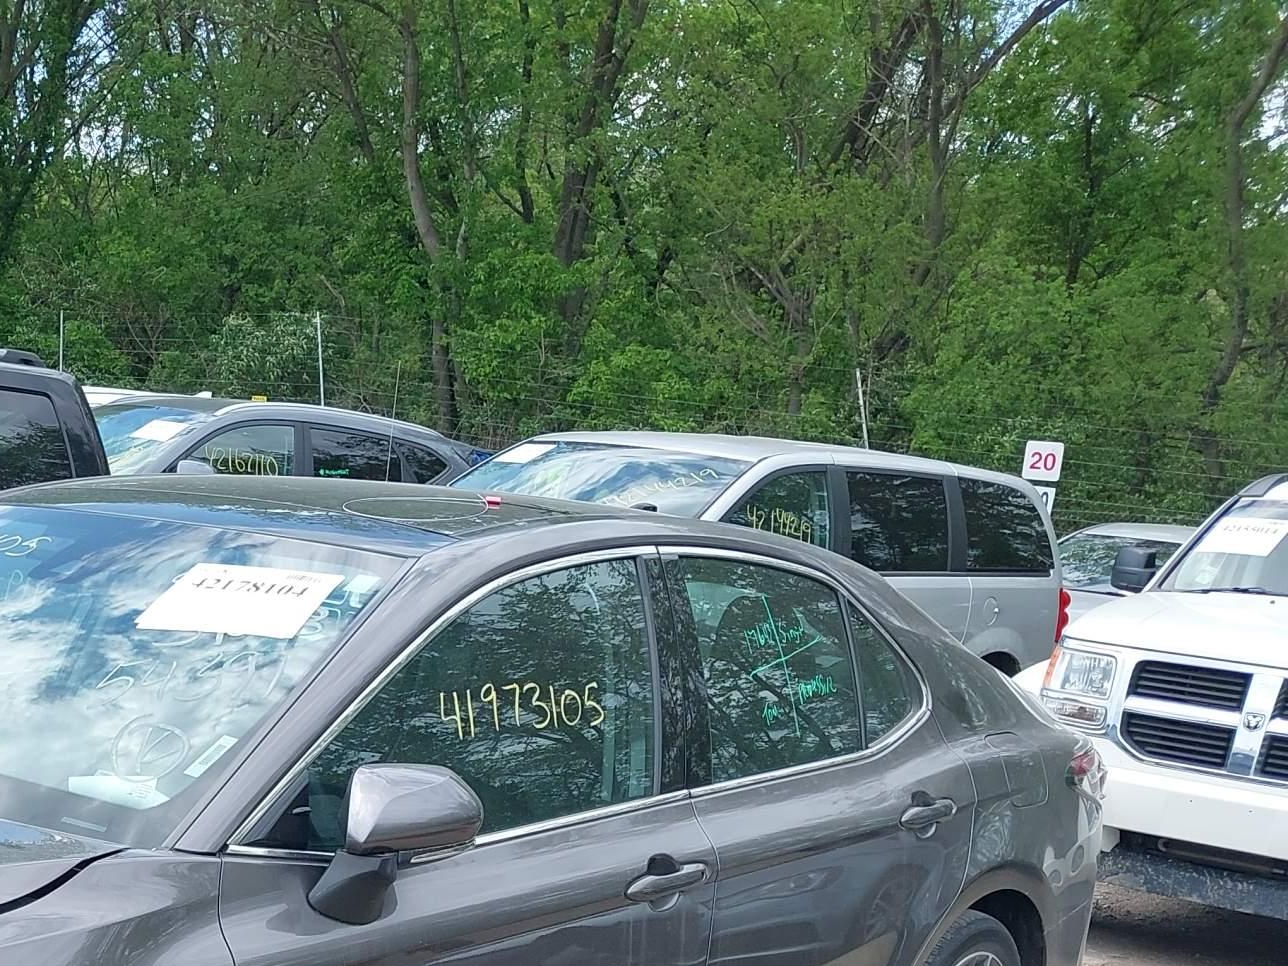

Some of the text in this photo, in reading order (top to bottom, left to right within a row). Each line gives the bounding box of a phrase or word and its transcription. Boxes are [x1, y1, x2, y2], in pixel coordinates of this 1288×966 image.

[1029, 451, 1057, 471] 20
[191, 577, 309, 598] 42178104
[439, 681, 605, 741] 41973105
